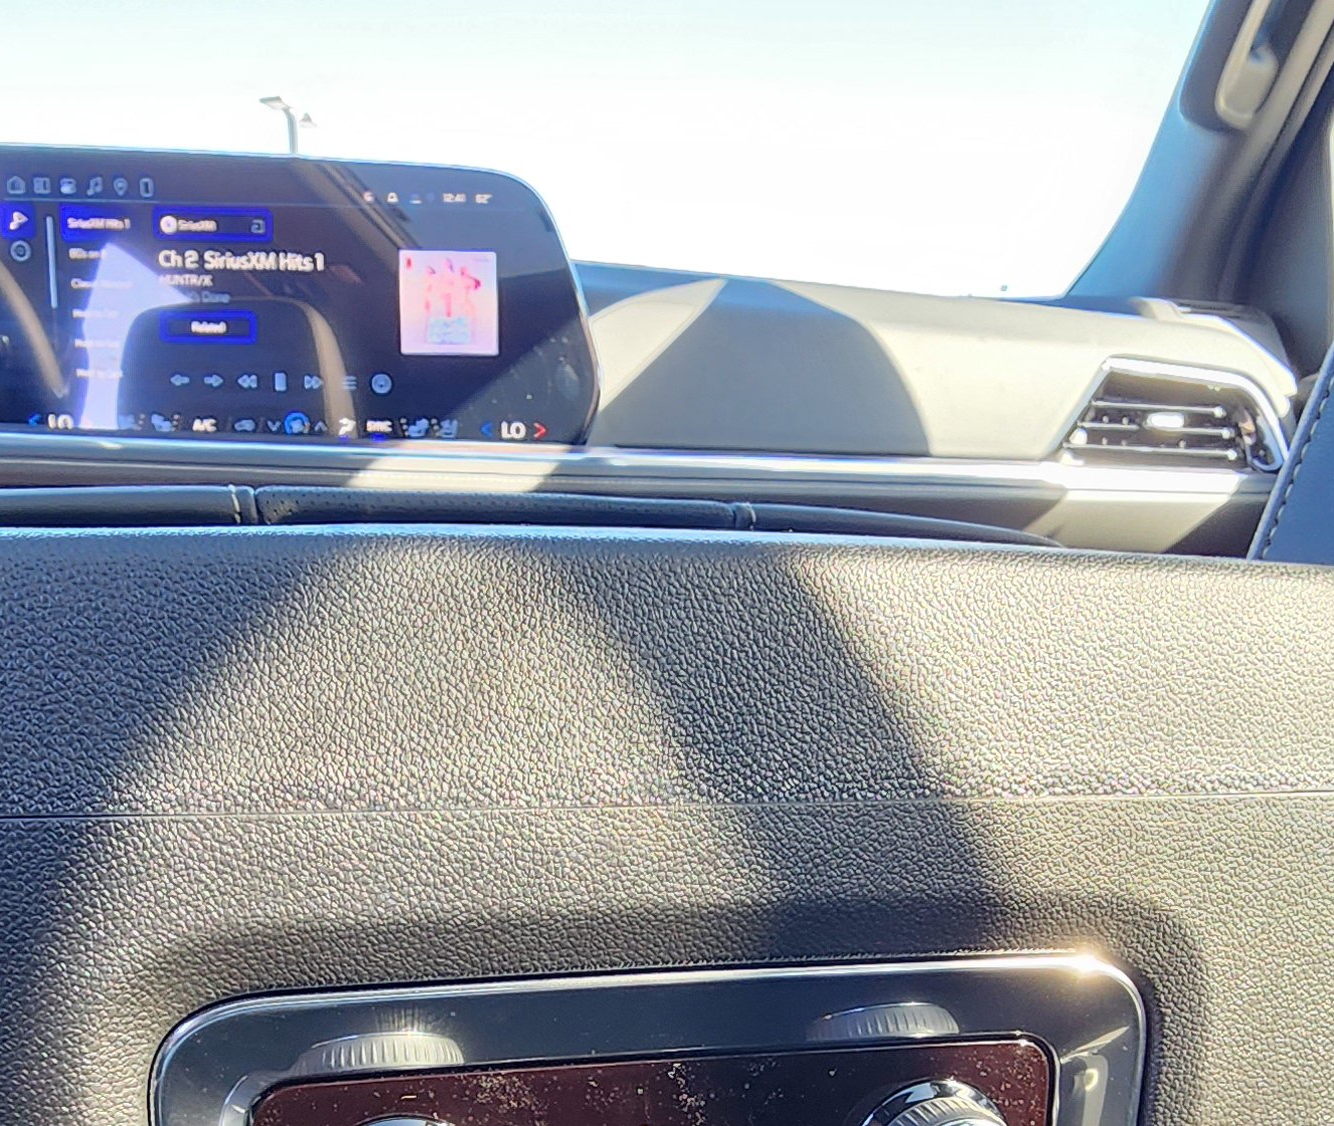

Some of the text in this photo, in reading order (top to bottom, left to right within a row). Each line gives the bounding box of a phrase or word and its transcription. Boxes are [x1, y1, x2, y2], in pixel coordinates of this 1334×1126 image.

[158, 250, 325, 272] Ch 2 SiriusXM Hits 1
[501, 420, 526, 439] LO
